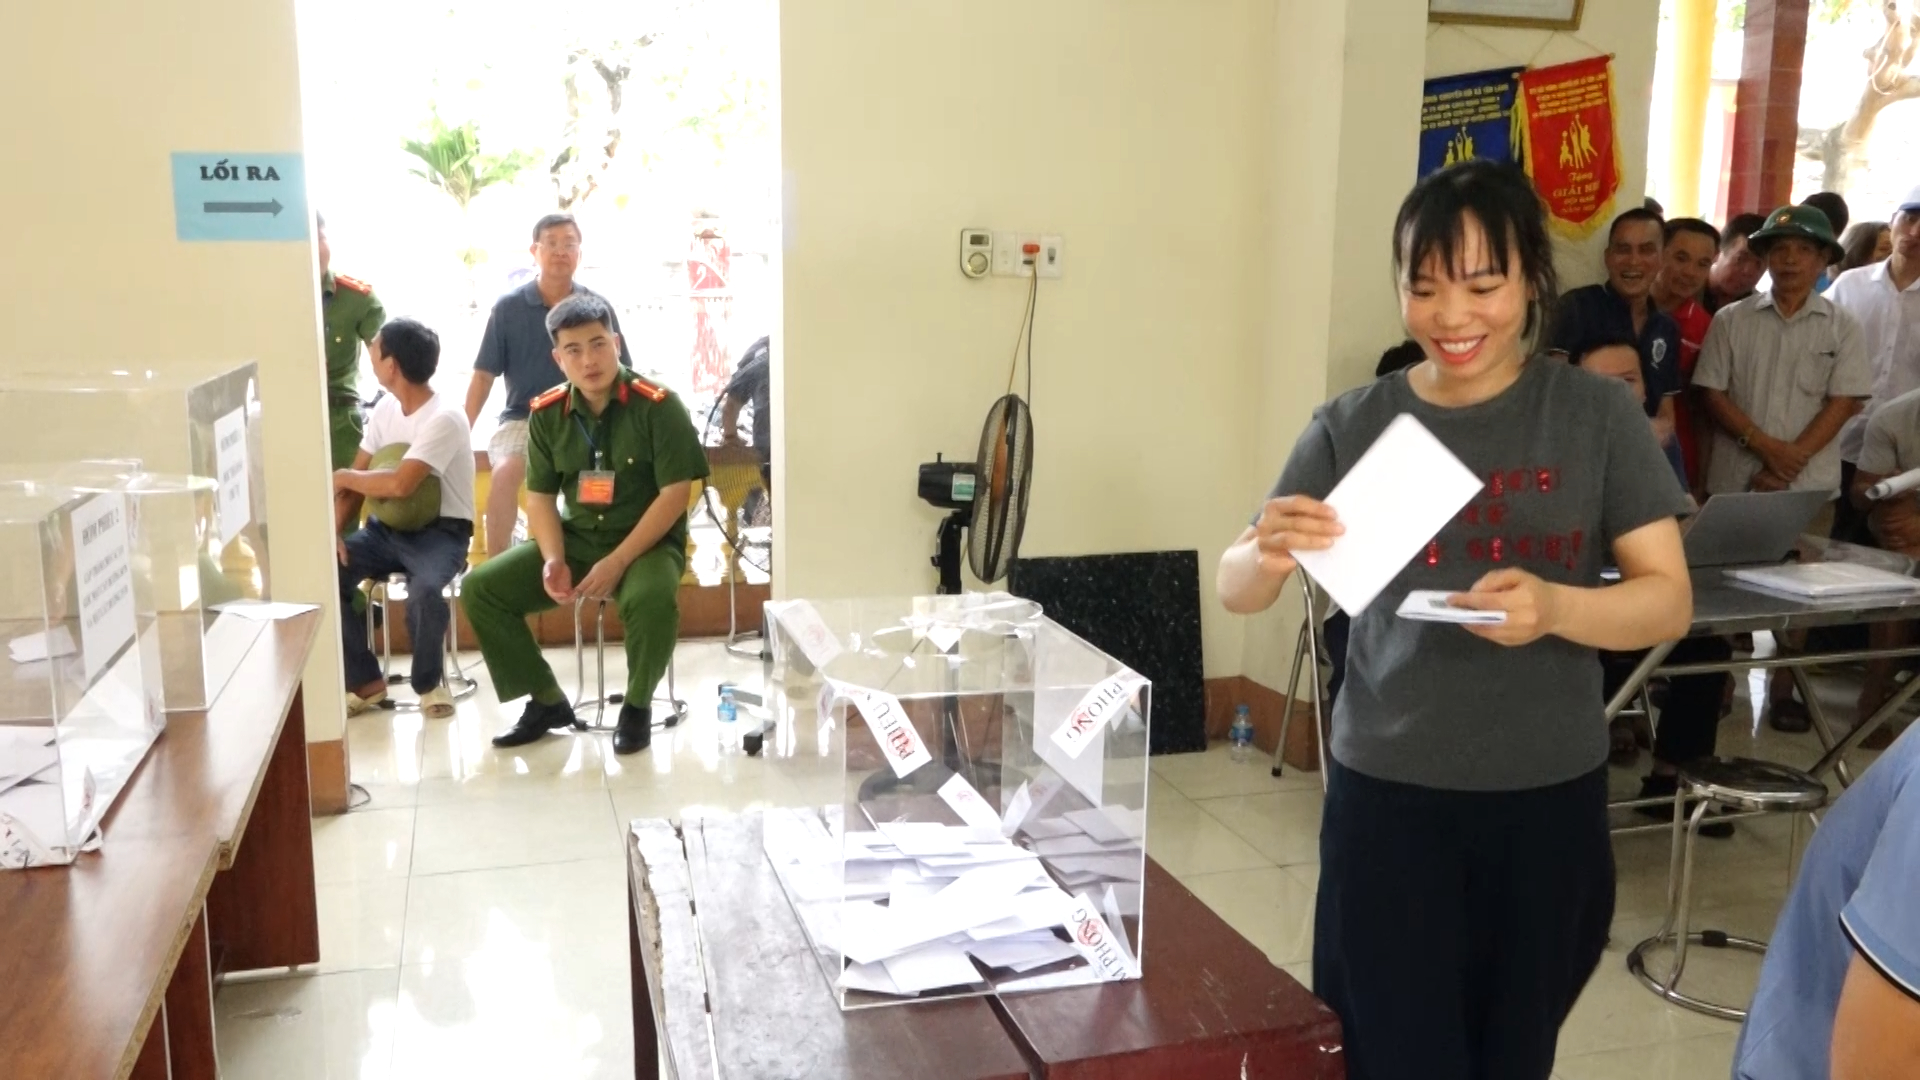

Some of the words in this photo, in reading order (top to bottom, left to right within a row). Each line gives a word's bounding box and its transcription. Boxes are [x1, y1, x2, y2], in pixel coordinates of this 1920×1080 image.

[199, 158, 240, 181] LỐI
[246, 165, 281, 181] RA
[1552, 185, 1582, 197] GIẢI
[1065, 681, 1123, 743] PHONG
[1071, 907, 1118, 968] PHONG
